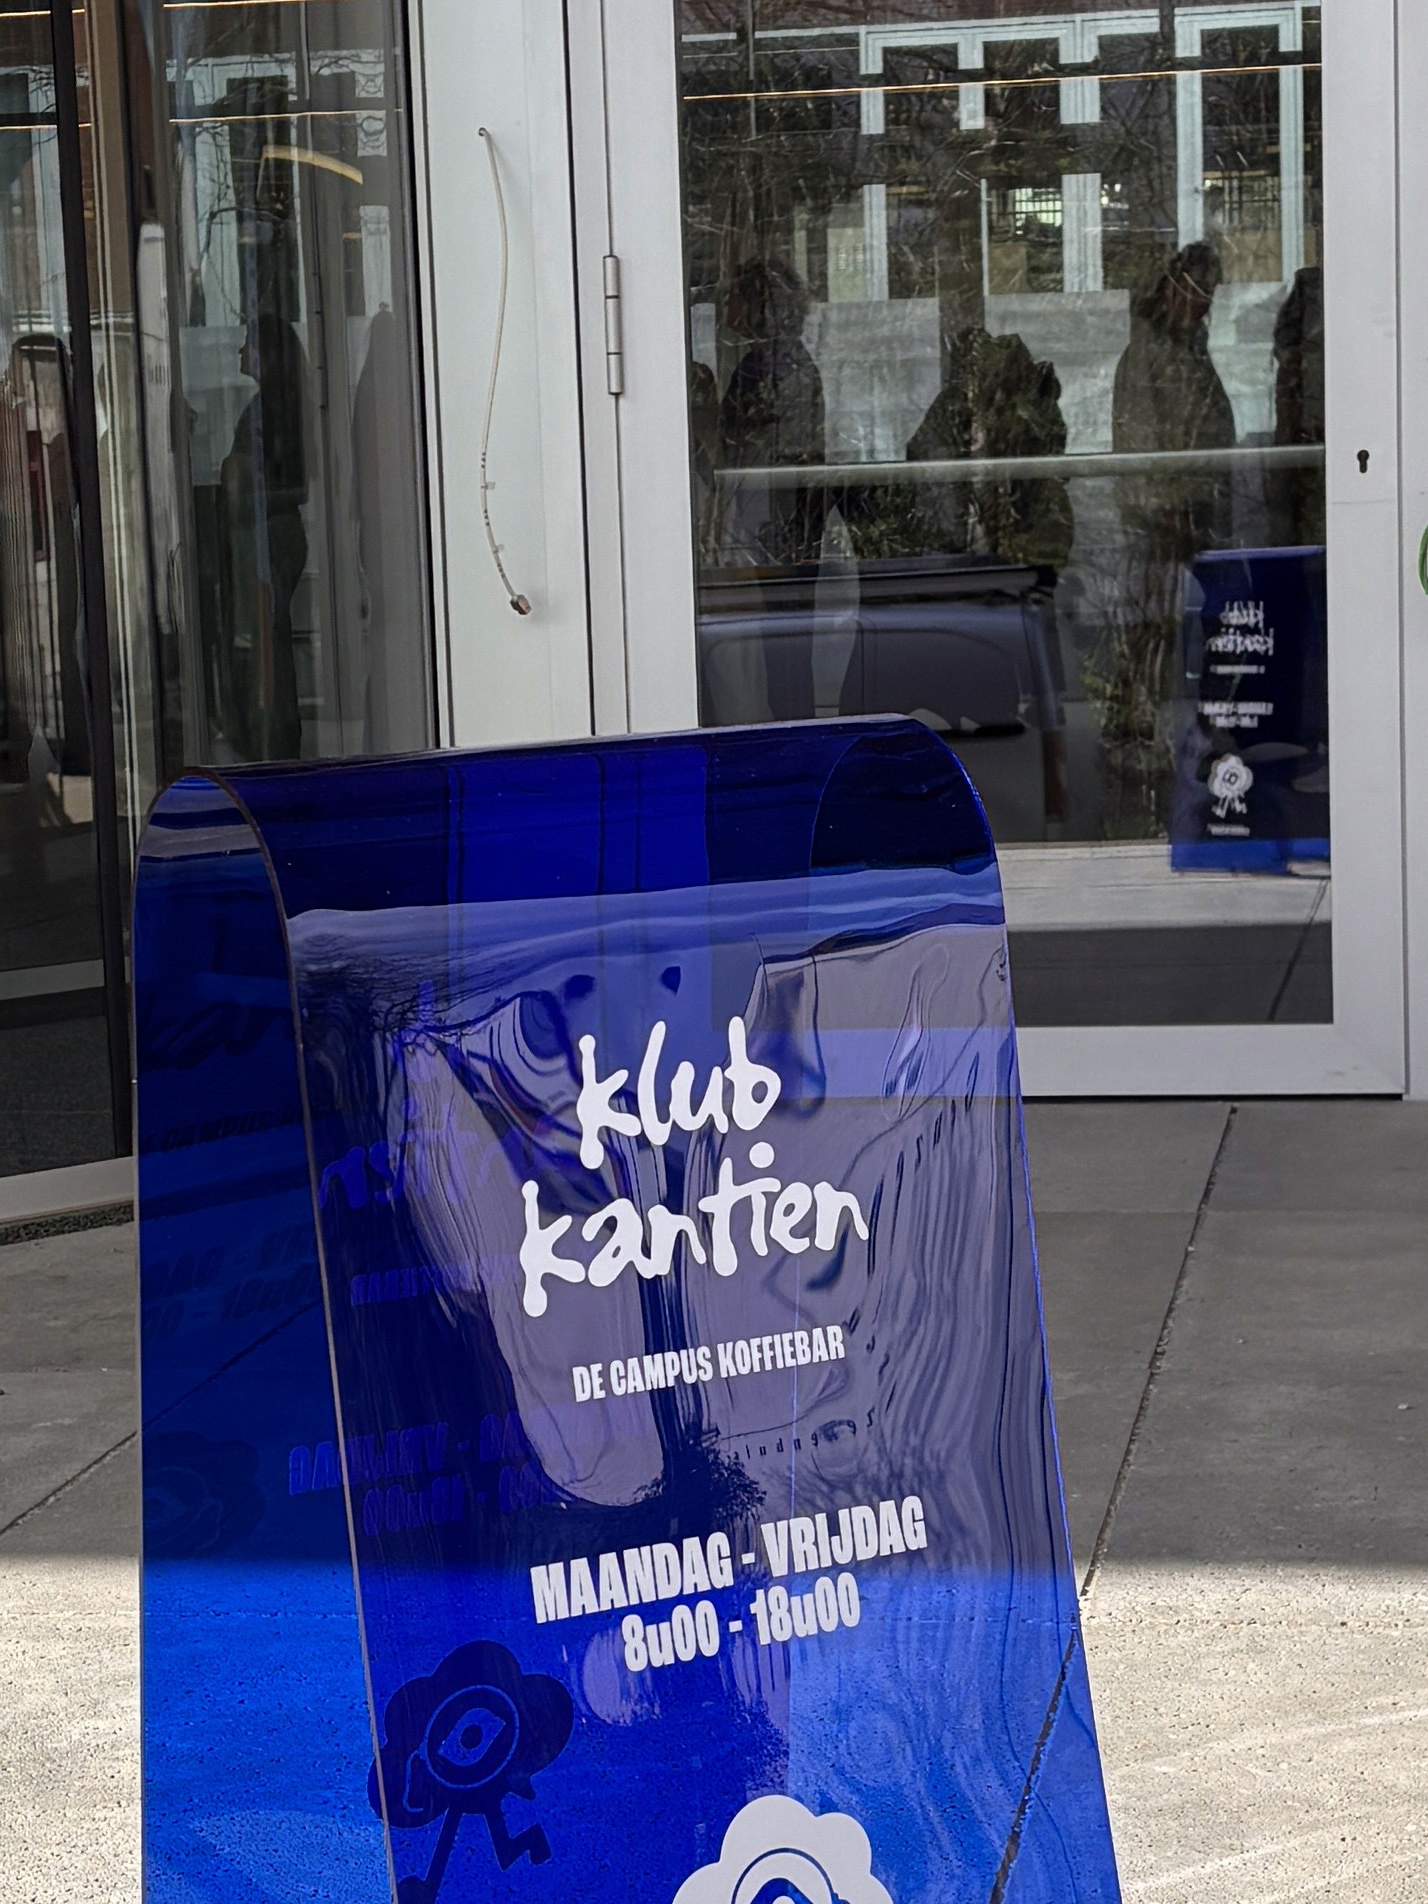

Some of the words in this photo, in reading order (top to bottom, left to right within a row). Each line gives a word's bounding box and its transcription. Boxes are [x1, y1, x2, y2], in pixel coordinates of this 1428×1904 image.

[576, 1016, 781, 1169] klub
[519, 1142, 869, 1317] kantien
[572, 1362, 606, 1403] DE
[609, 1345, 714, 1396] CAMPUS
[717, 1324, 846, 1379] KOFFIEBAR
[530, 1531, 735, 1624] MAANDAG
[741, 1552, 756, 1565] -
[761, 1495, 928, 1577] VRIJDAG
[621, 1600, 720, 1673] 8u00
[728, 1619, 743, 1633] -
[750, 1571, 861, 1646] 18u00
